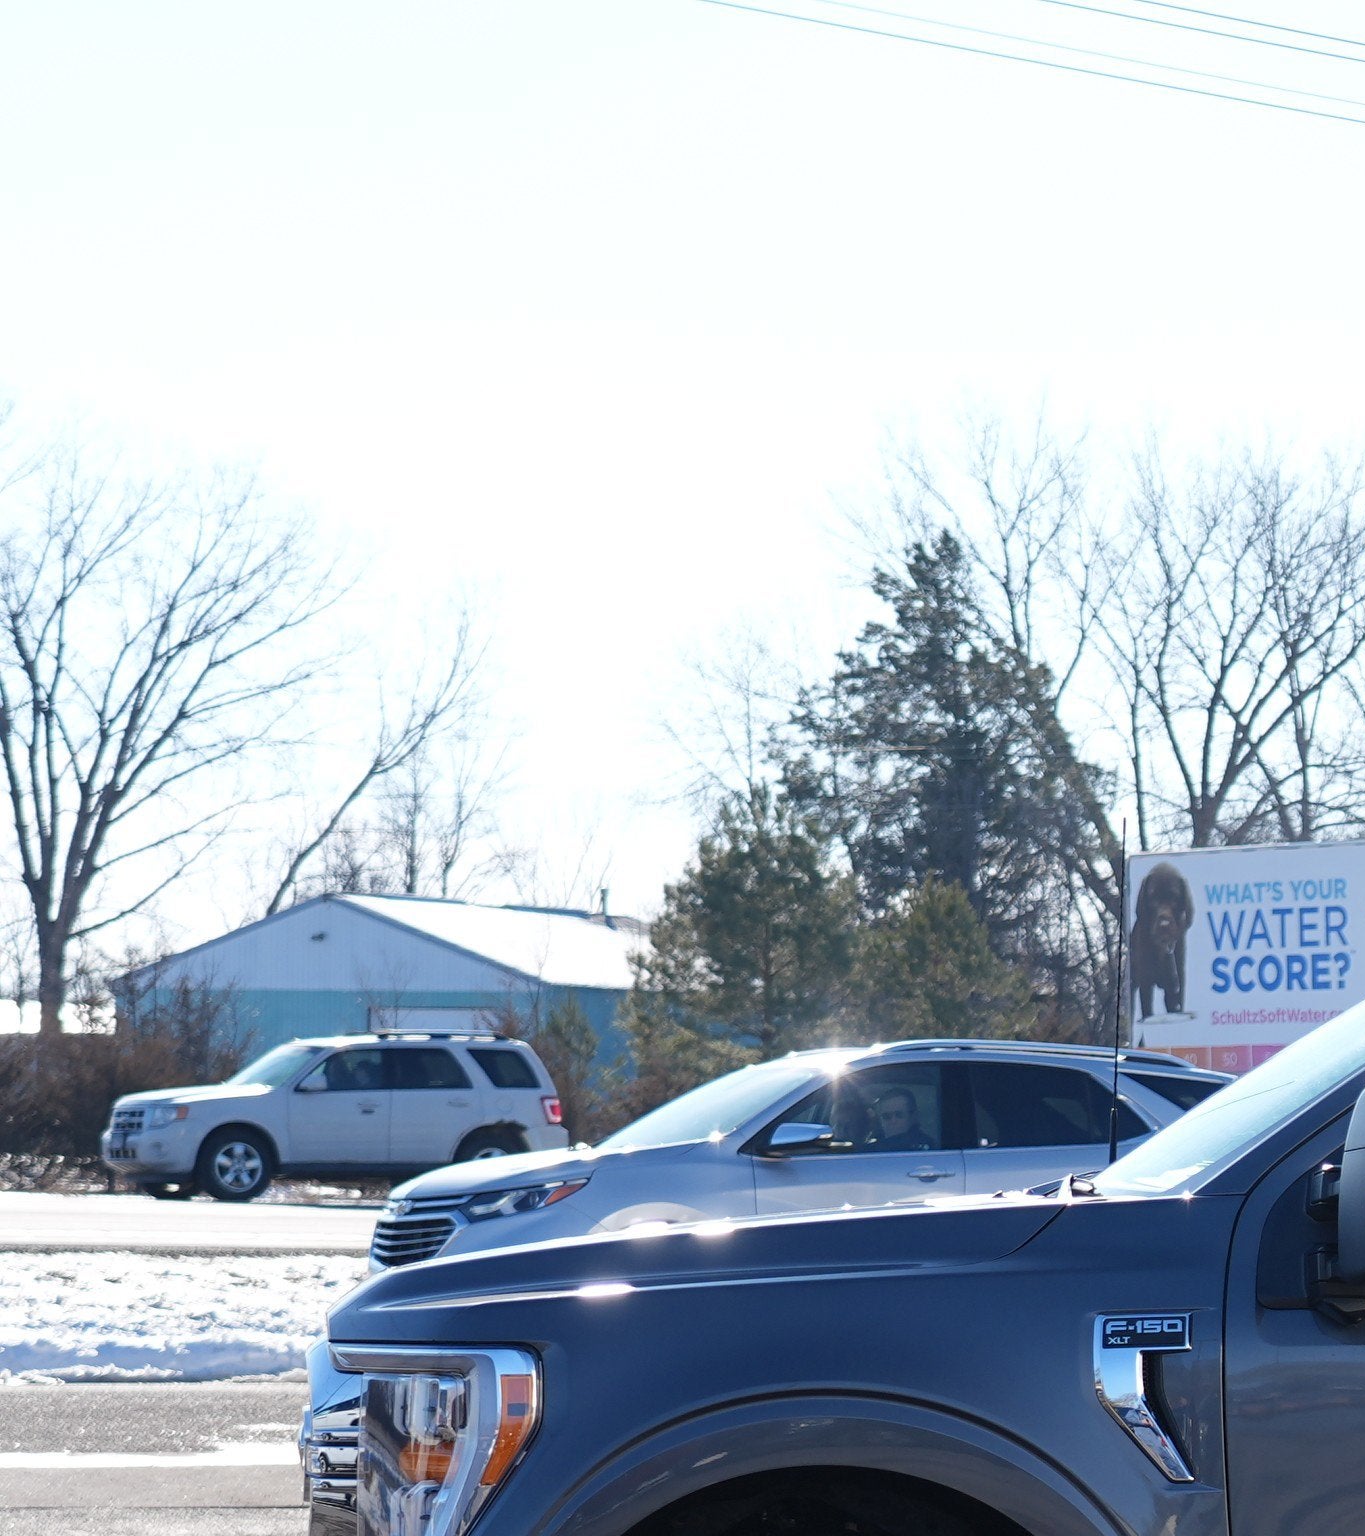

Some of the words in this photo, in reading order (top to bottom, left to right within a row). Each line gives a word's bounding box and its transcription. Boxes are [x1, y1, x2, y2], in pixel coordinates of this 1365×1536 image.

[1204, 881, 1284, 905] WHAT'S
[1289, 878, 1348, 901] YOUR
[1206, 905, 1349, 951] WATER
[1211, 952, 1352, 994] SCORE?
[1105, 1318, 1183, 1335] F-150
[1107, 1335, 1131, 1345] XLT
